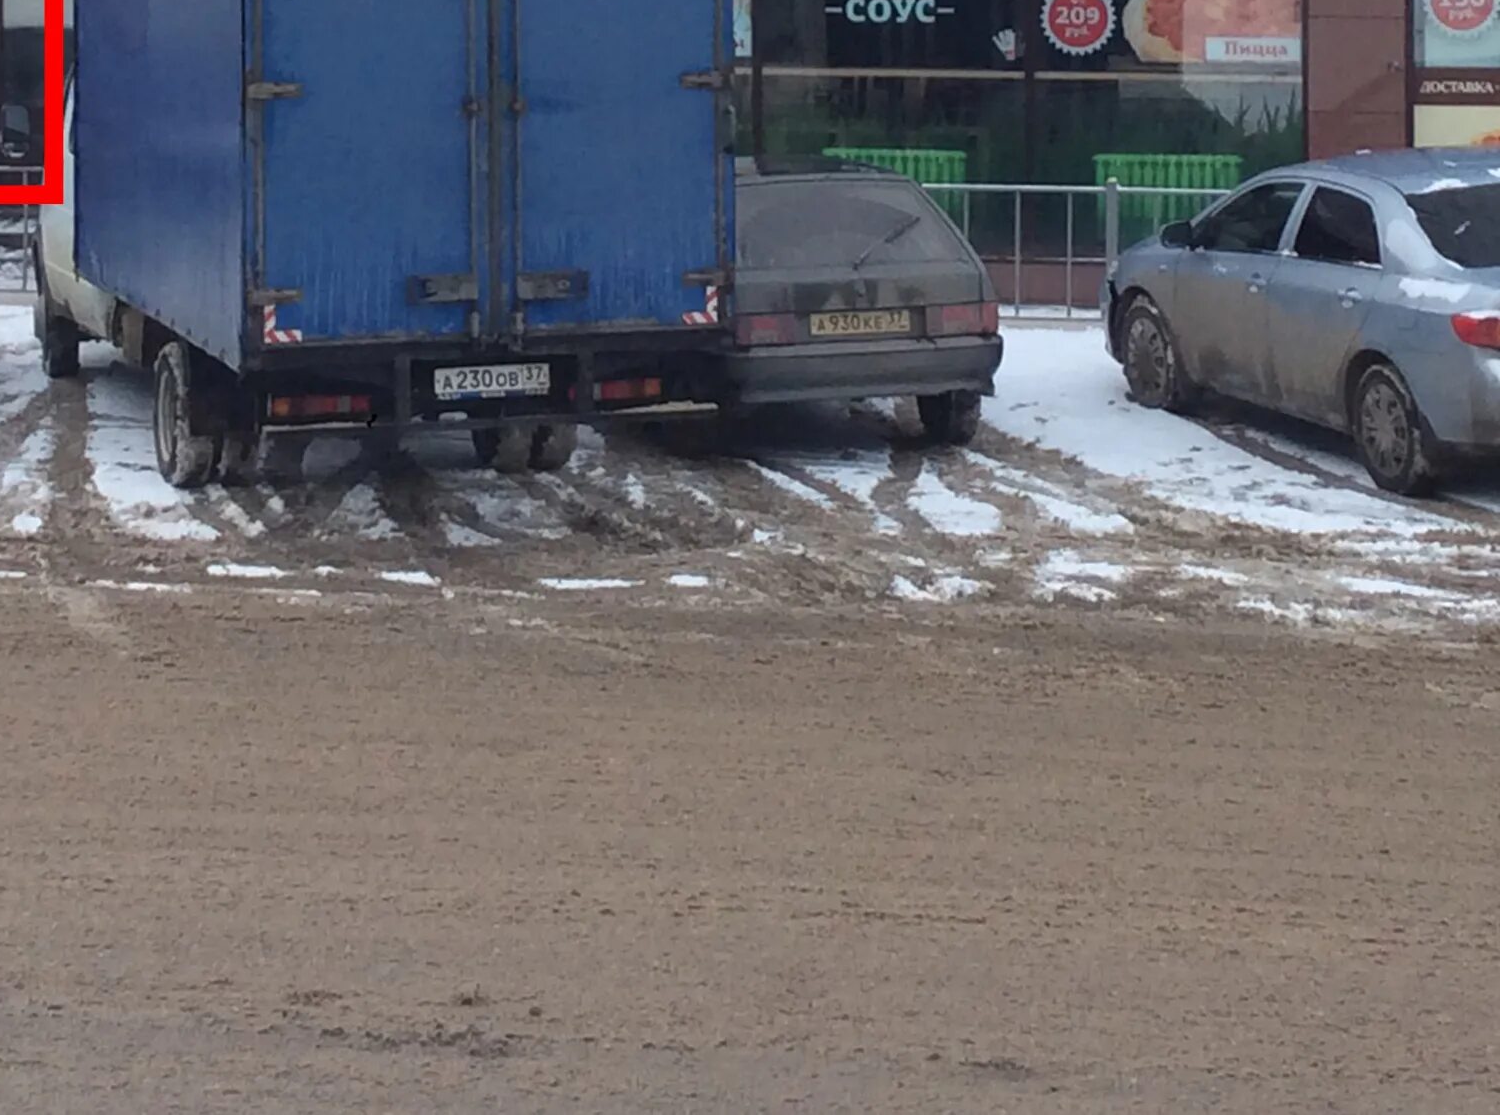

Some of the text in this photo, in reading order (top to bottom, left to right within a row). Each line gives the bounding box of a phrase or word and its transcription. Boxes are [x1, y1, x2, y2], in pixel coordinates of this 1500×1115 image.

[1055, 6, 1100, 25] 209
[1225, 40, 1288, 57] Пицца
[1420, 80, 1494, 94] ДОСТАВКА
[443, 369, 519, 390] А230ОВ
